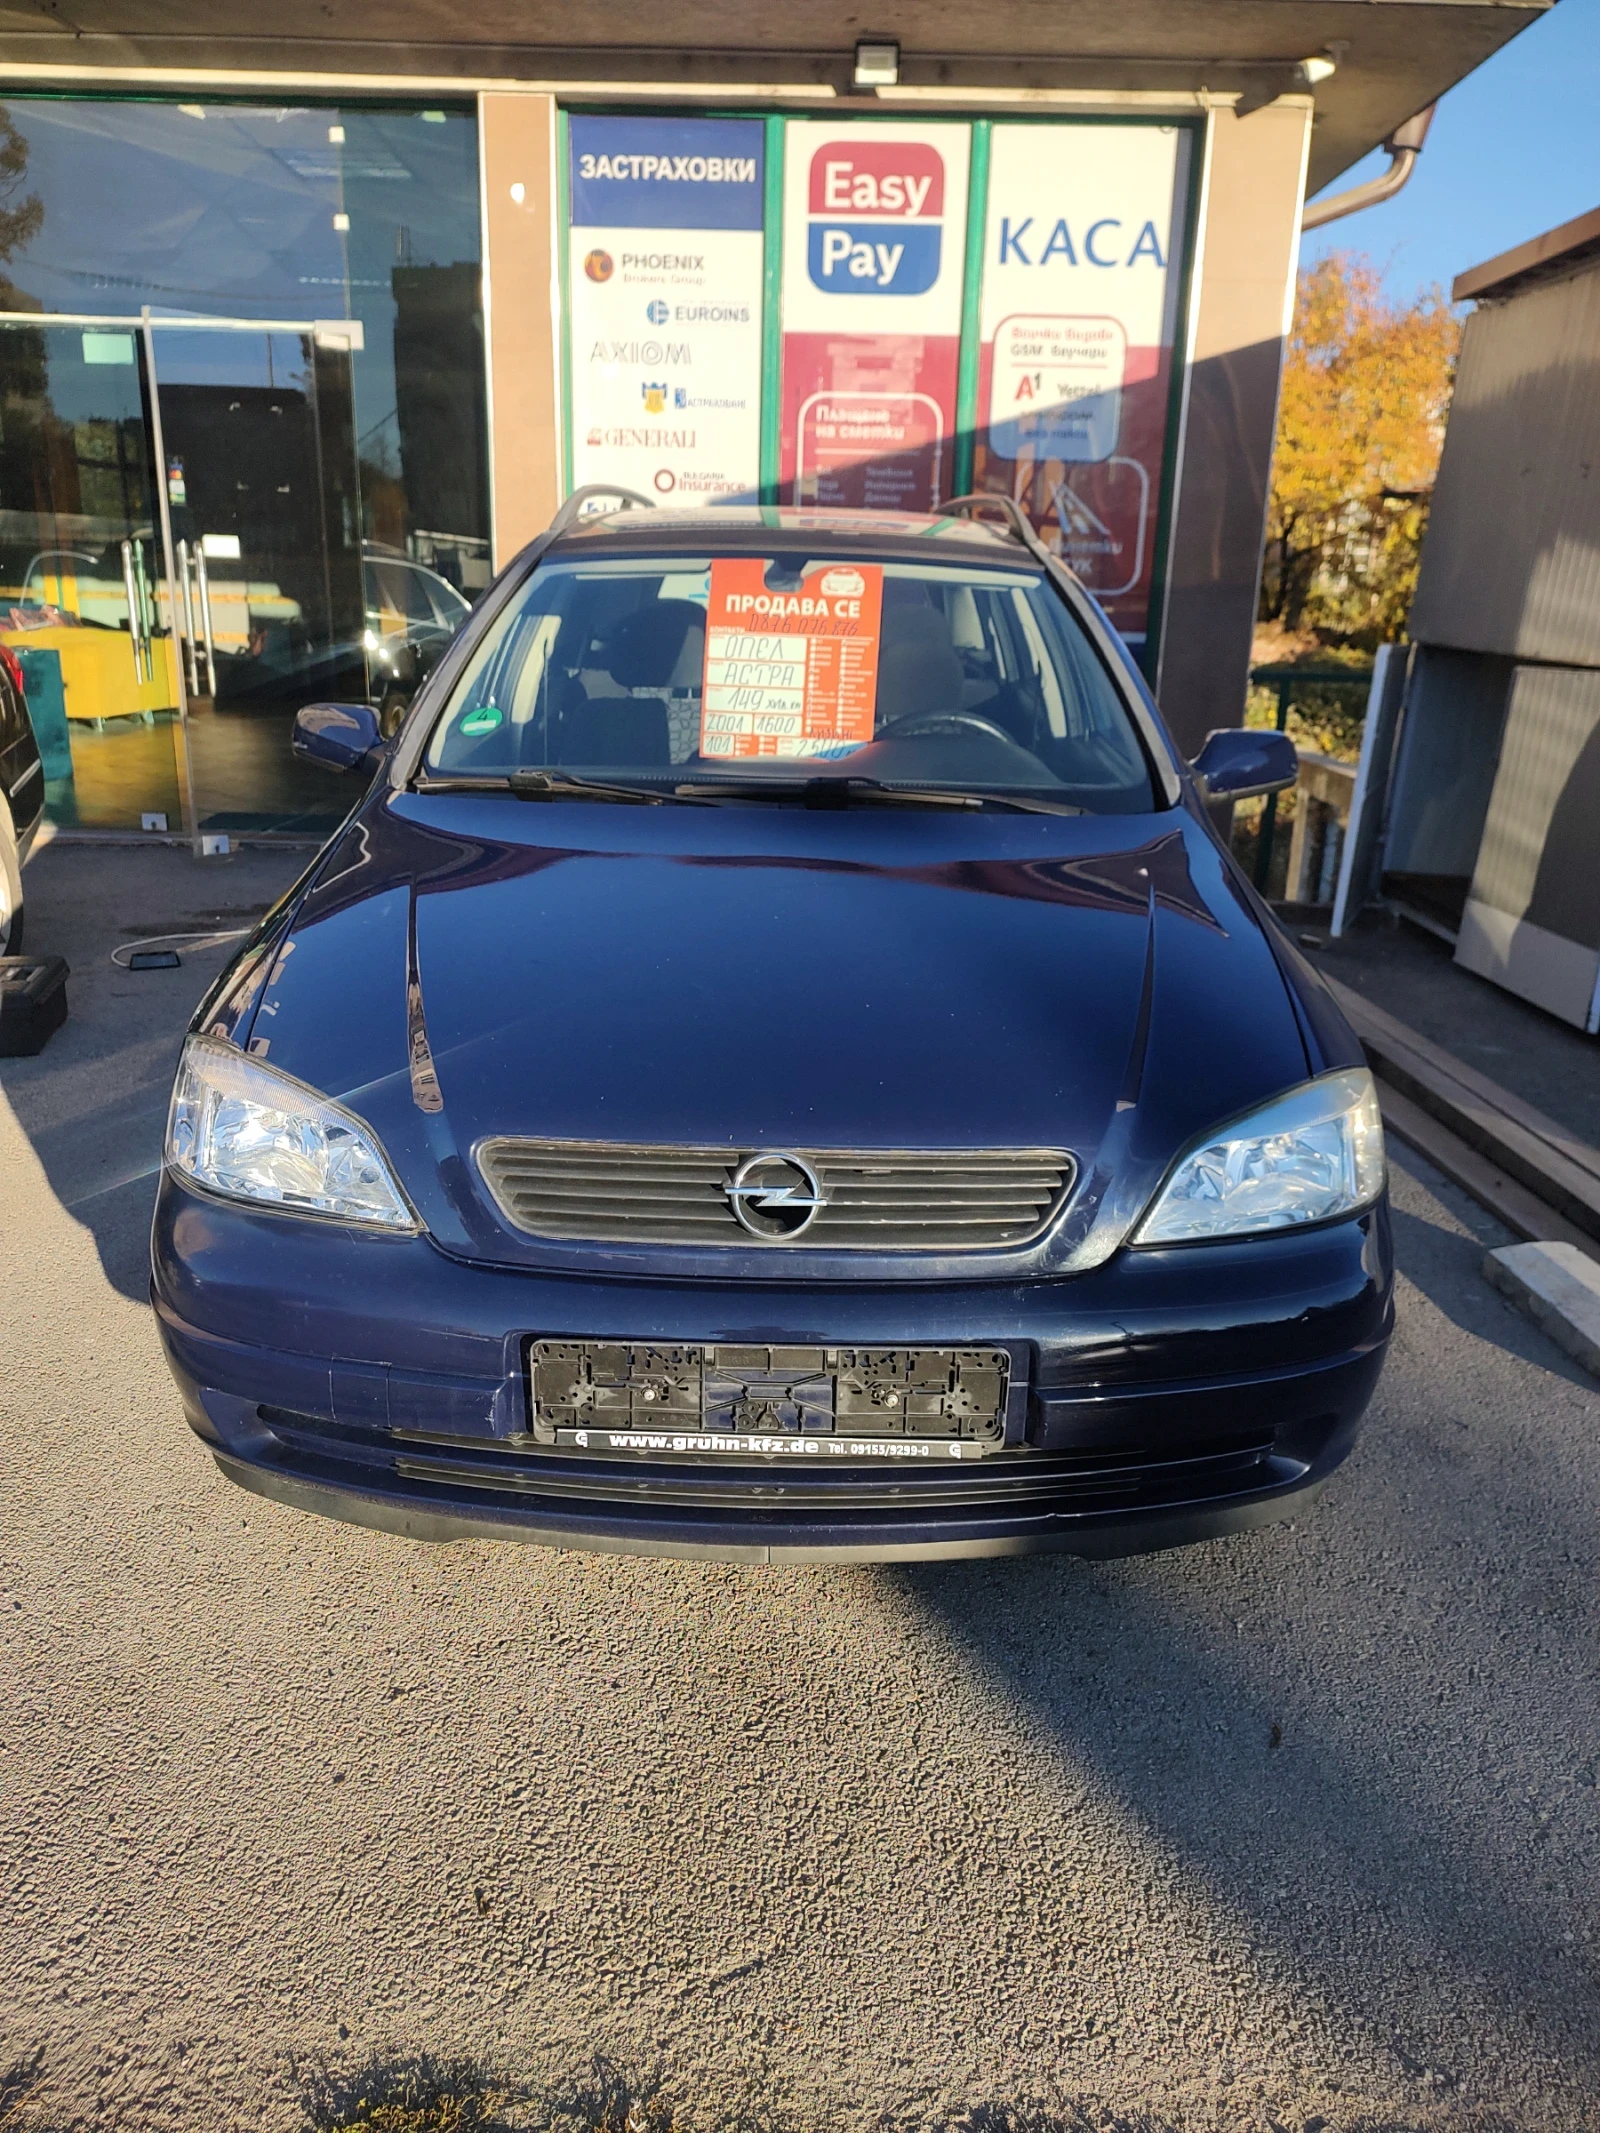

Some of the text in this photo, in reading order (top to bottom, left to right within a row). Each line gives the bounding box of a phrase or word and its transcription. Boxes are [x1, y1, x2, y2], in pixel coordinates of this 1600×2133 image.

[579, 153, 757, 183] ЗАСТРАХОВКИ
[824, 160, 932, 217] Easy
[999, 217, 1168, 268] КАСА
[621, 253, 705, 271] PHOENIX
[822, 229, 904, 286] Pay
[675, 306, 750, 322] EUROINS
[590, 340, 692, 366] AXIOM
[1011, 343, 1043, 357] GSM
[1014, 371, 1041, 401] A1
[605, 428, 697, 449] GENERALI
[816, 425, 837, 440] на
[726, 594, 861, 618] ПРОДАВА СЕ
[724, 662, 795, 687] АСТРА
[727, 687, 764, 710] 149
[477, 708, 488, 721] 4
[707, 713, 744, 733] 2001
[756, 716, 796, 734] 1600
[609, 1434, 819, 1454] www.gruhn-kfz.de
[828, 1443, 847, 1455] Tel.
